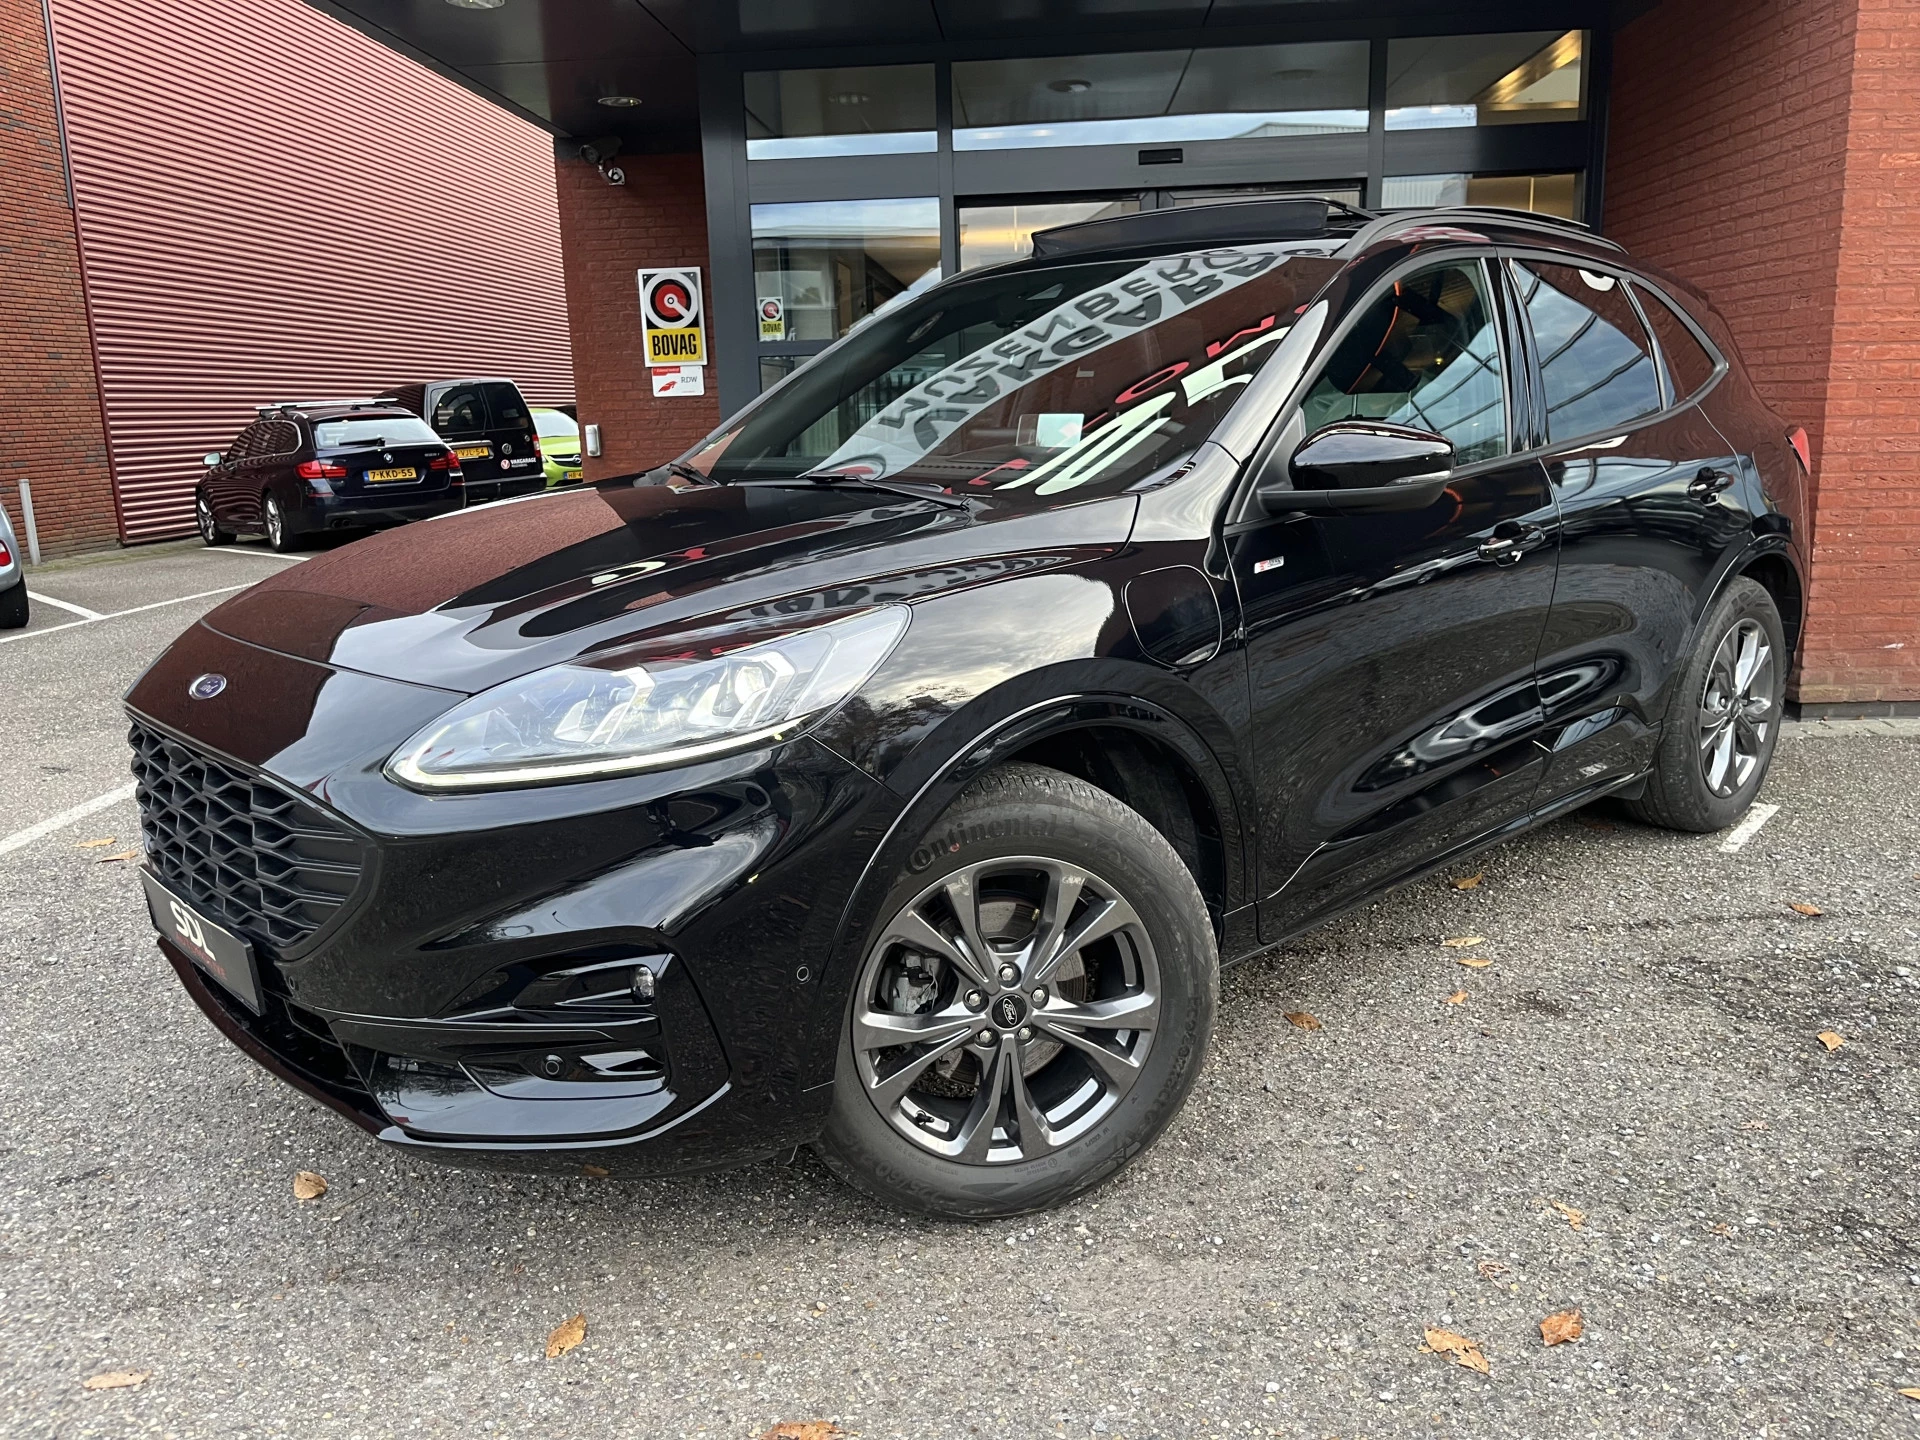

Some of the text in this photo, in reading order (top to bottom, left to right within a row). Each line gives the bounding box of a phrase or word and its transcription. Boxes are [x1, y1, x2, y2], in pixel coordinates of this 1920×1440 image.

[652, 333, 697, 356] BOVAG
[680, 376, 698, 384] RDW
[370, 468, 413, 480] 7-KKD-55
[169, 900, 217, 961] SDL
